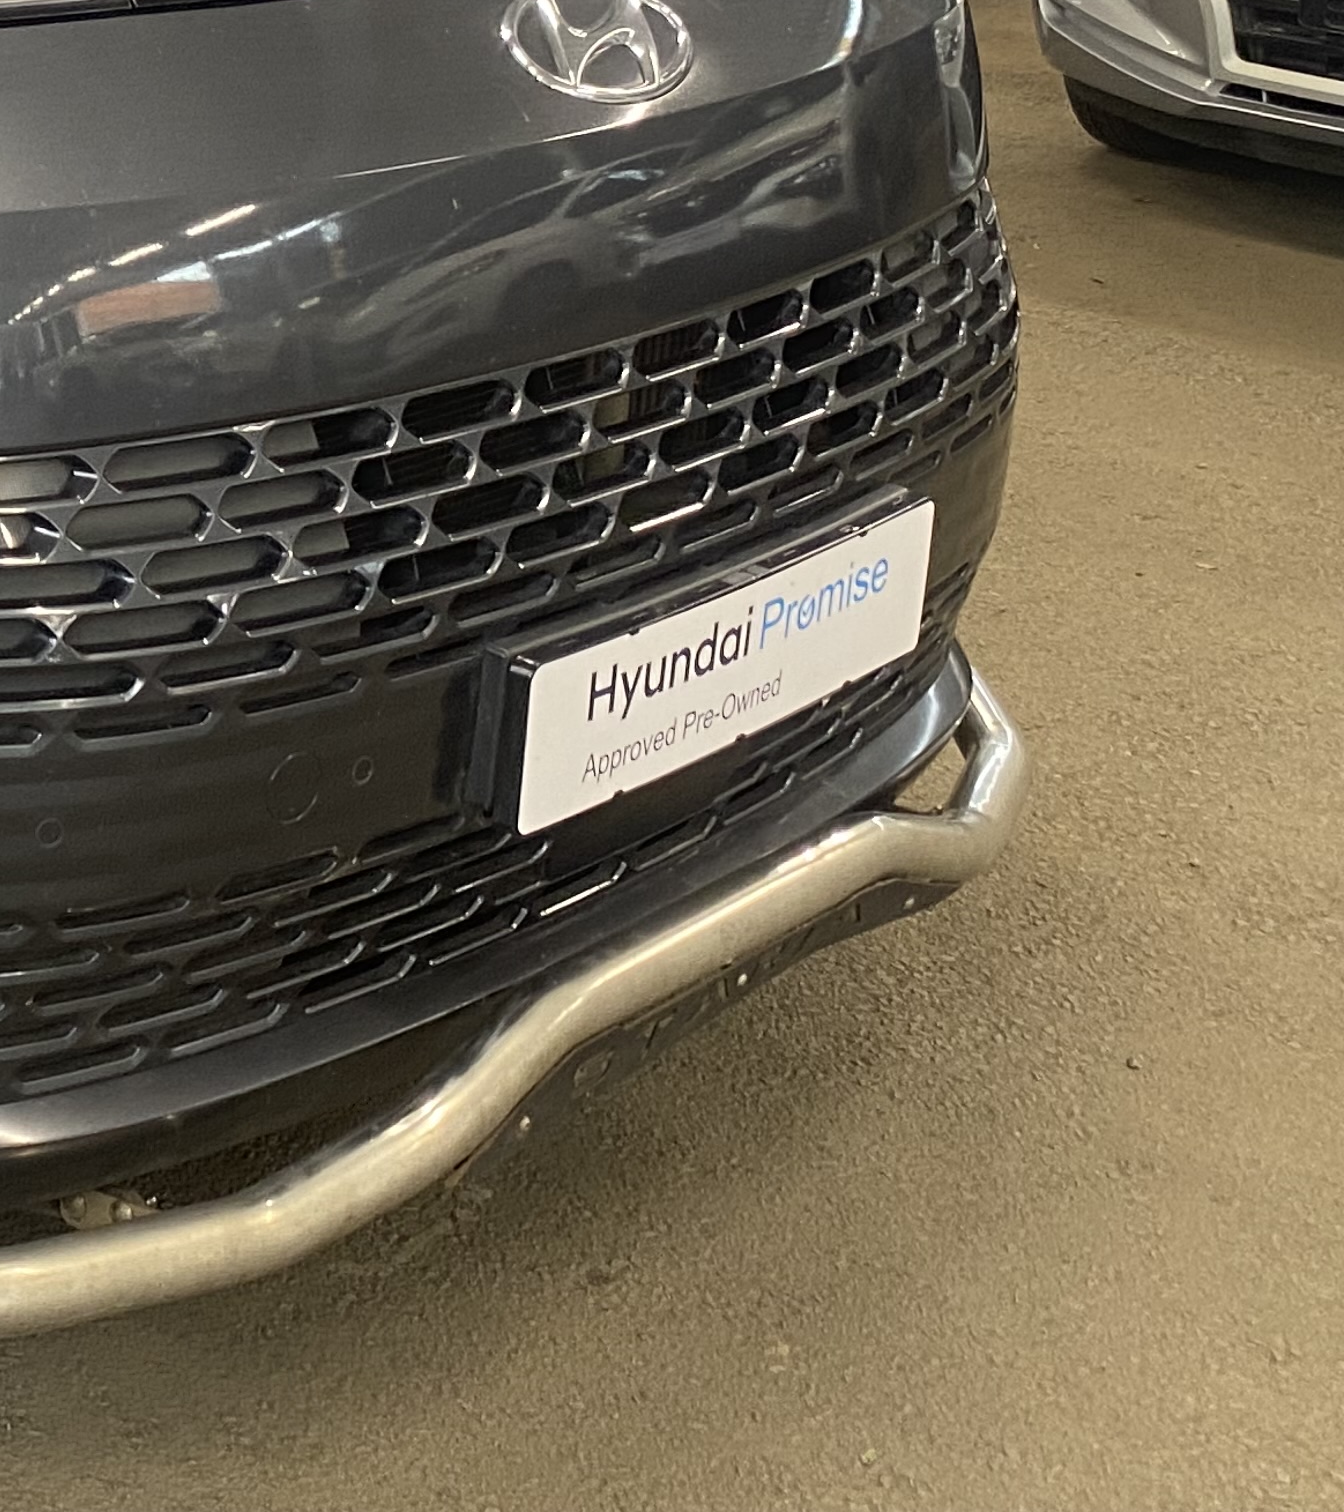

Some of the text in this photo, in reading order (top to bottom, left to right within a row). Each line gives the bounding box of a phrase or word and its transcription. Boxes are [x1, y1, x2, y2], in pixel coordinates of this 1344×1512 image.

[586, 556, 889, 722] Hyundai Promise
[580, 670, 782, 783] Approved Pre-Owned
